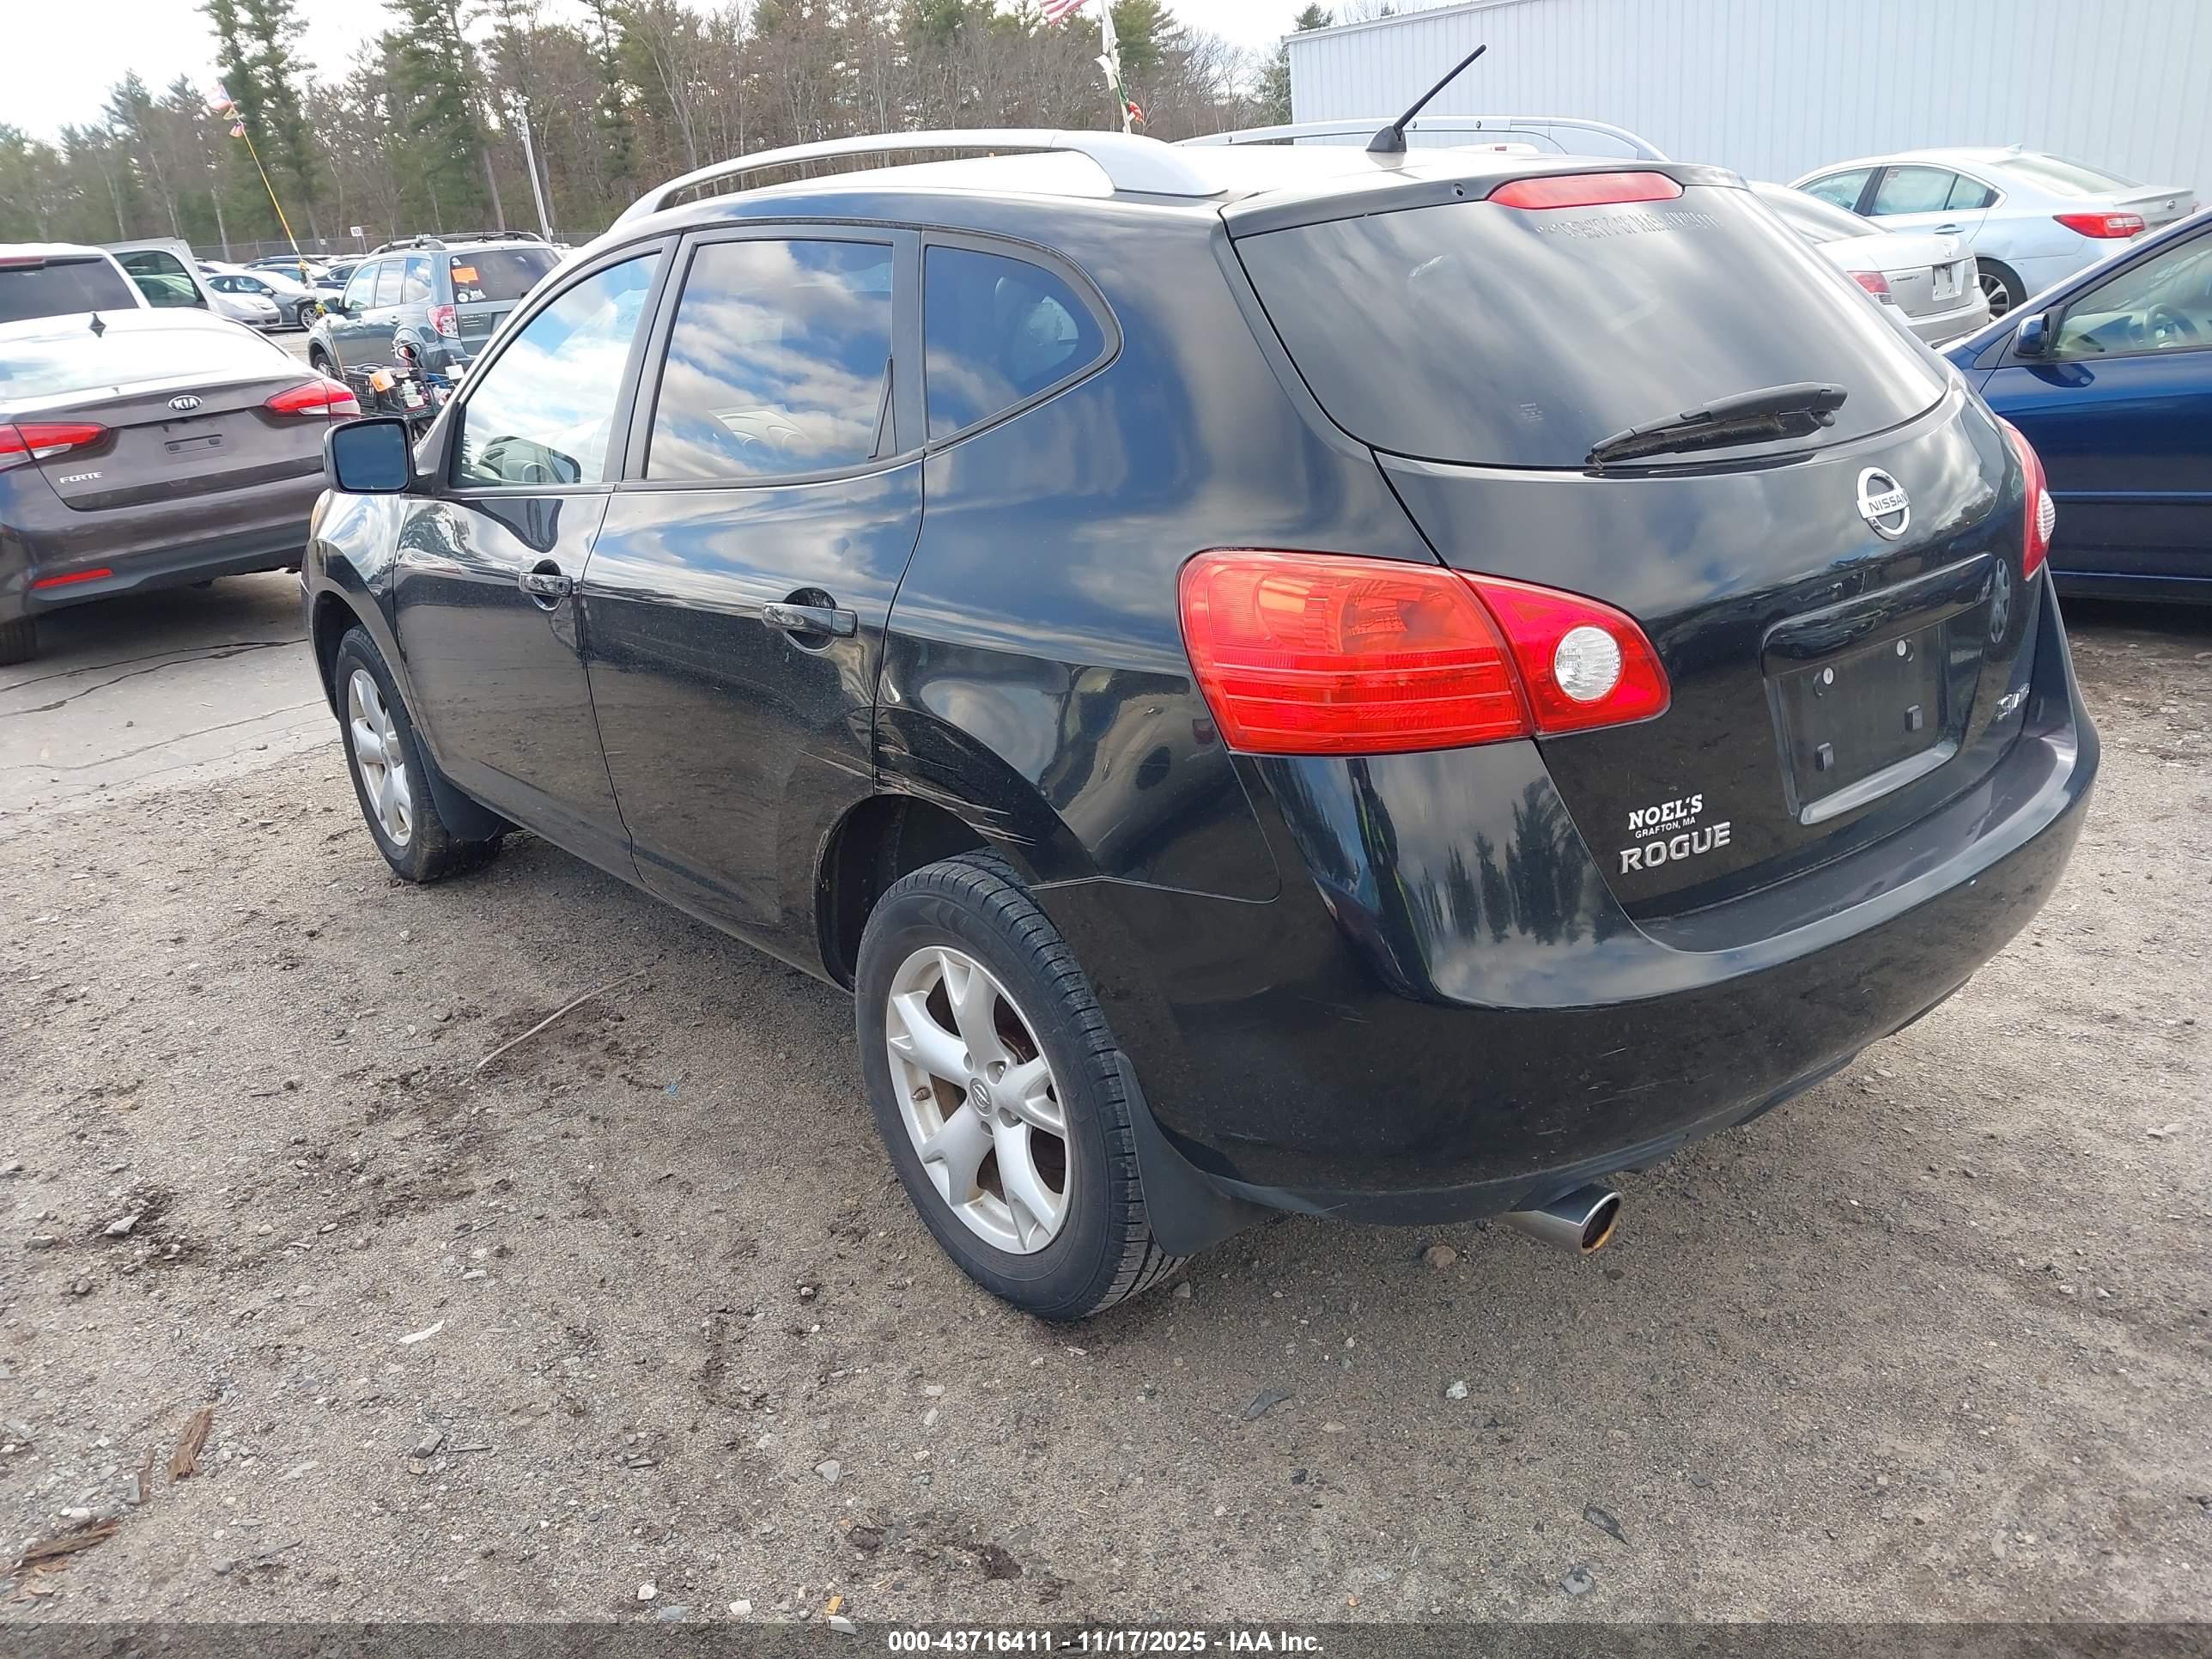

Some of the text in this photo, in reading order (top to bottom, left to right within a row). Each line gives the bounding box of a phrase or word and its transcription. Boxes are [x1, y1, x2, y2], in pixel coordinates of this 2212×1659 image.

[173, 398, 198, 410] KIA
[59, 471, 103, 483] FORTE
[1868, 493, 1909, 513] NISSAN
[1628, 793, 1703, 830] NOEL'S
[1635, 816, 1696, 839] GRAFTON, MA
[1620, 821, 1731, 874] ROGUE
